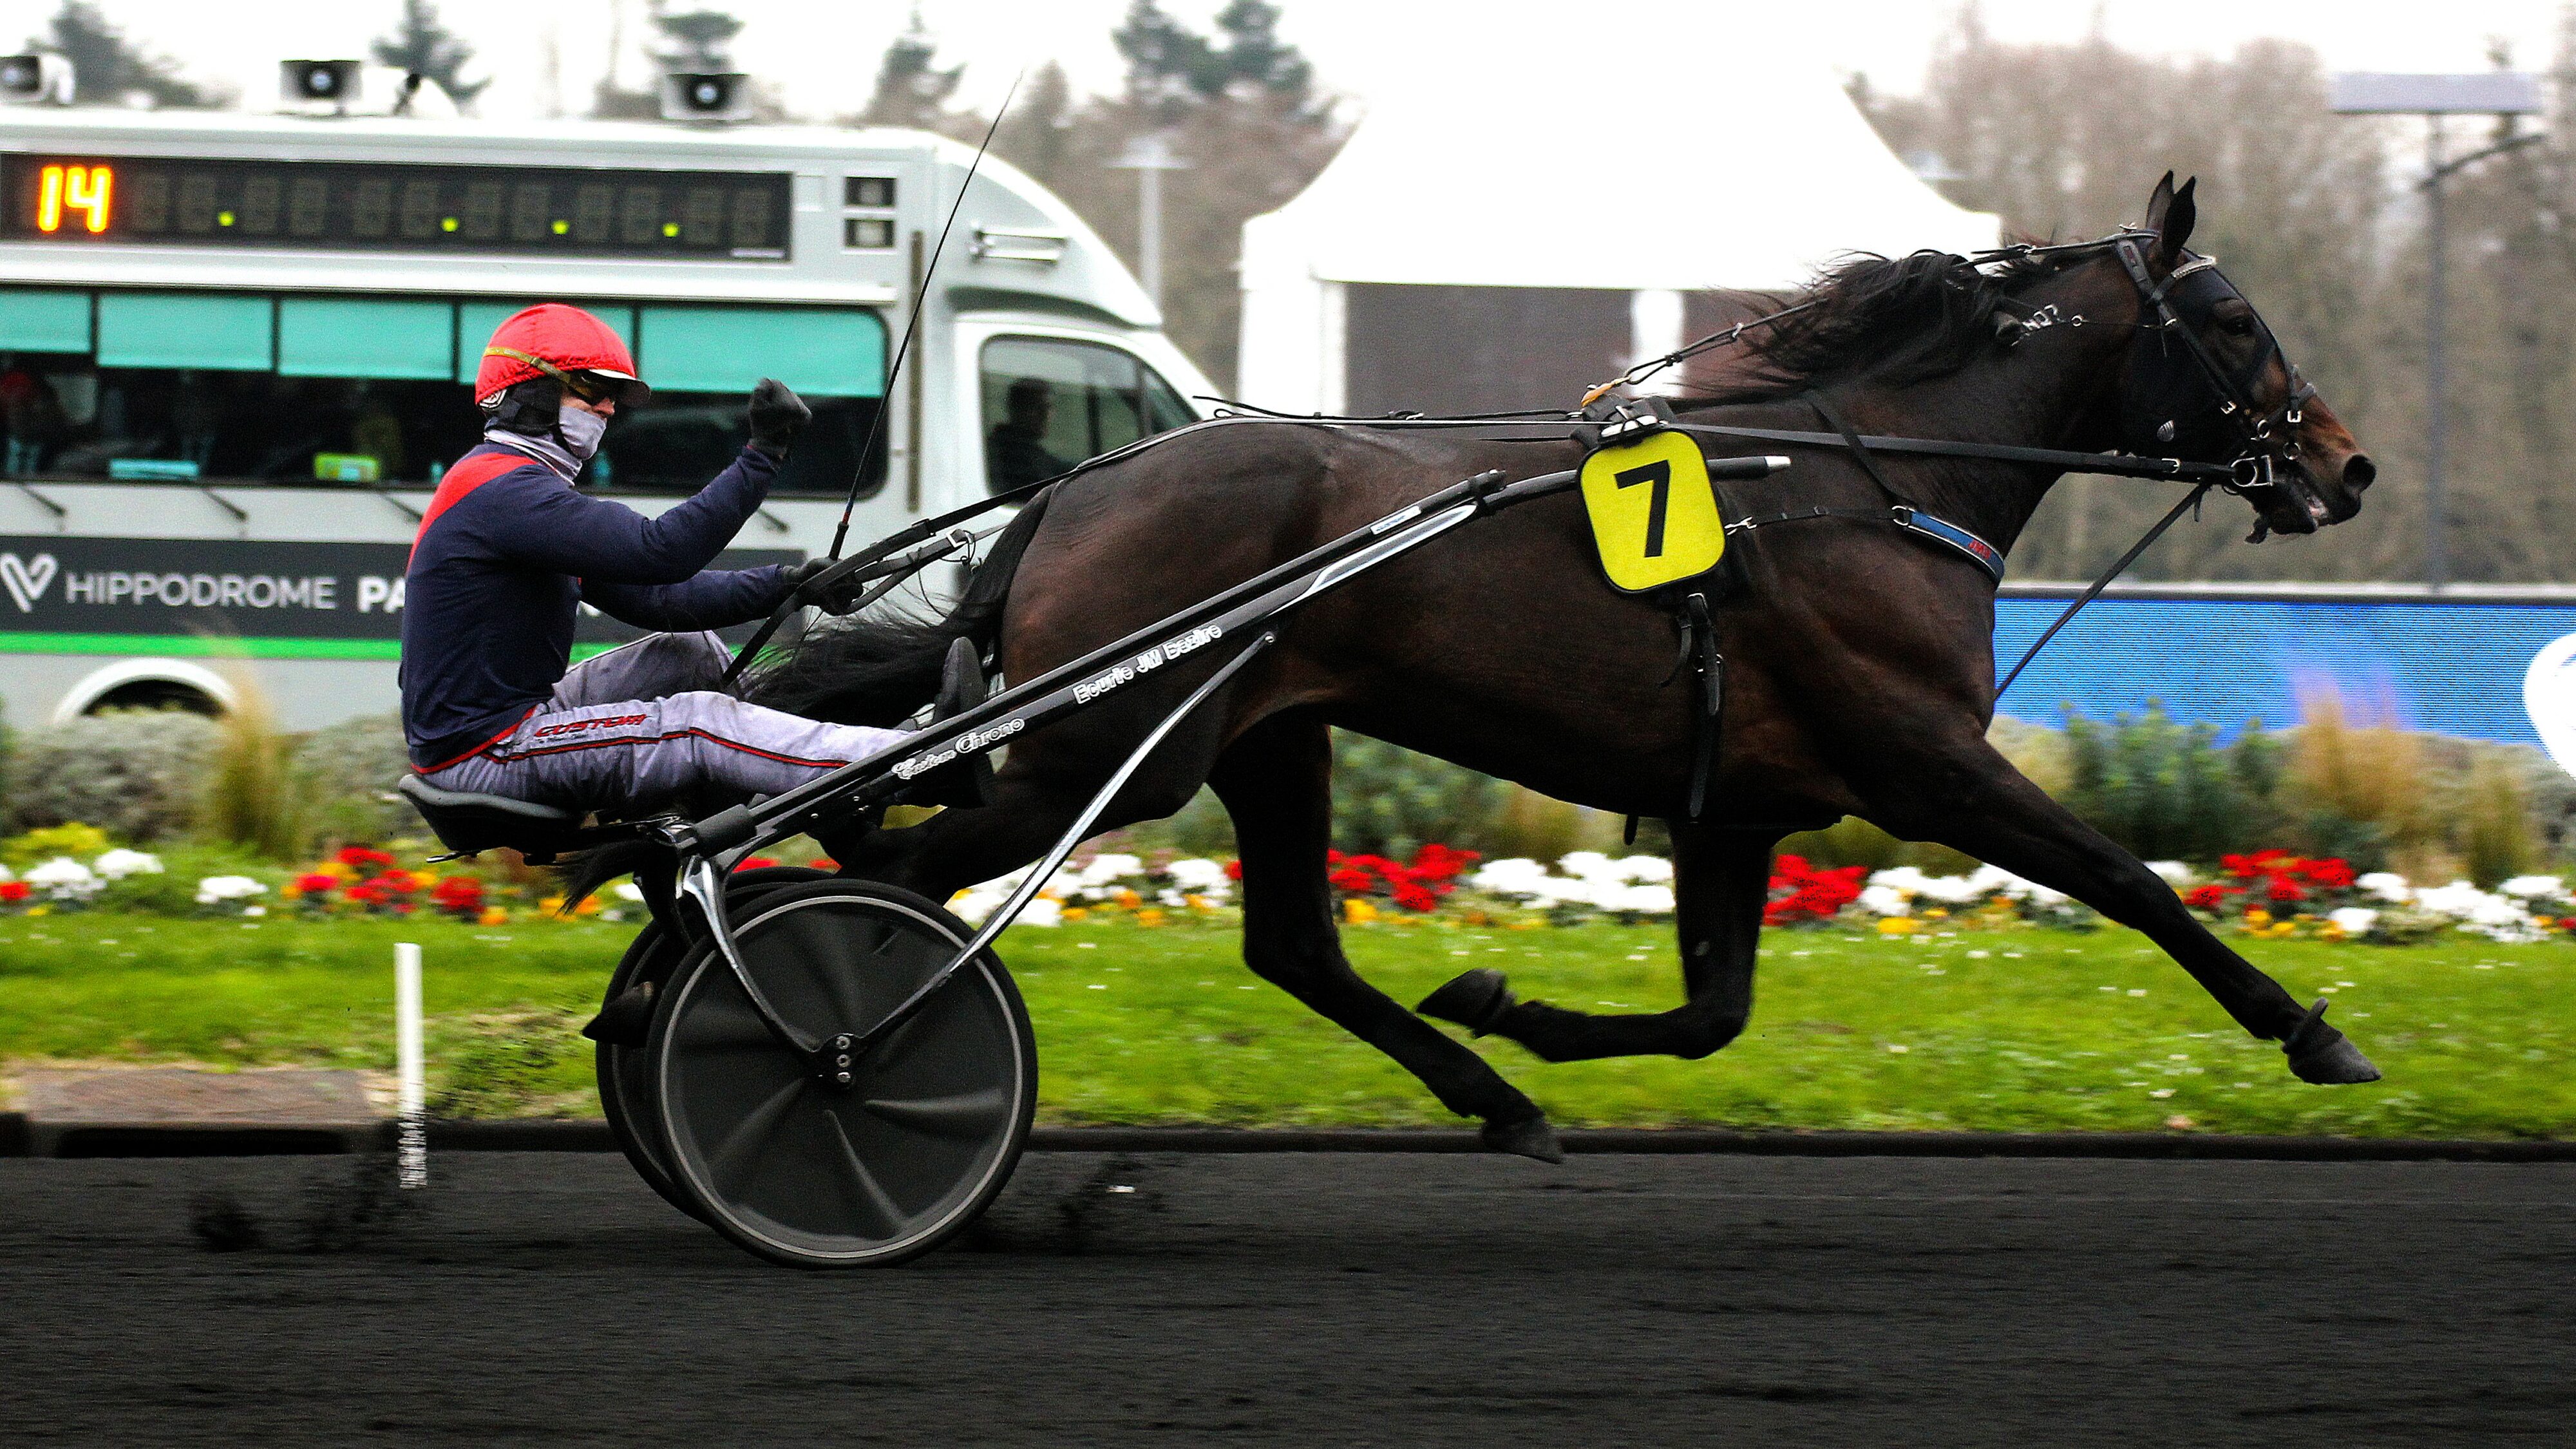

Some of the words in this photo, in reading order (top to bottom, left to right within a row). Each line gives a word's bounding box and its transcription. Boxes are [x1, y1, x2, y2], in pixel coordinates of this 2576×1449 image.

[37, 164, 113, 233] 14
[1614, 459, 1671, 558] 7
[65, 571, 337, 611] HIPPODROME
[1072, 665, 1134, 704] Ecurie
[955, 718, 1025, 753] Chrono
